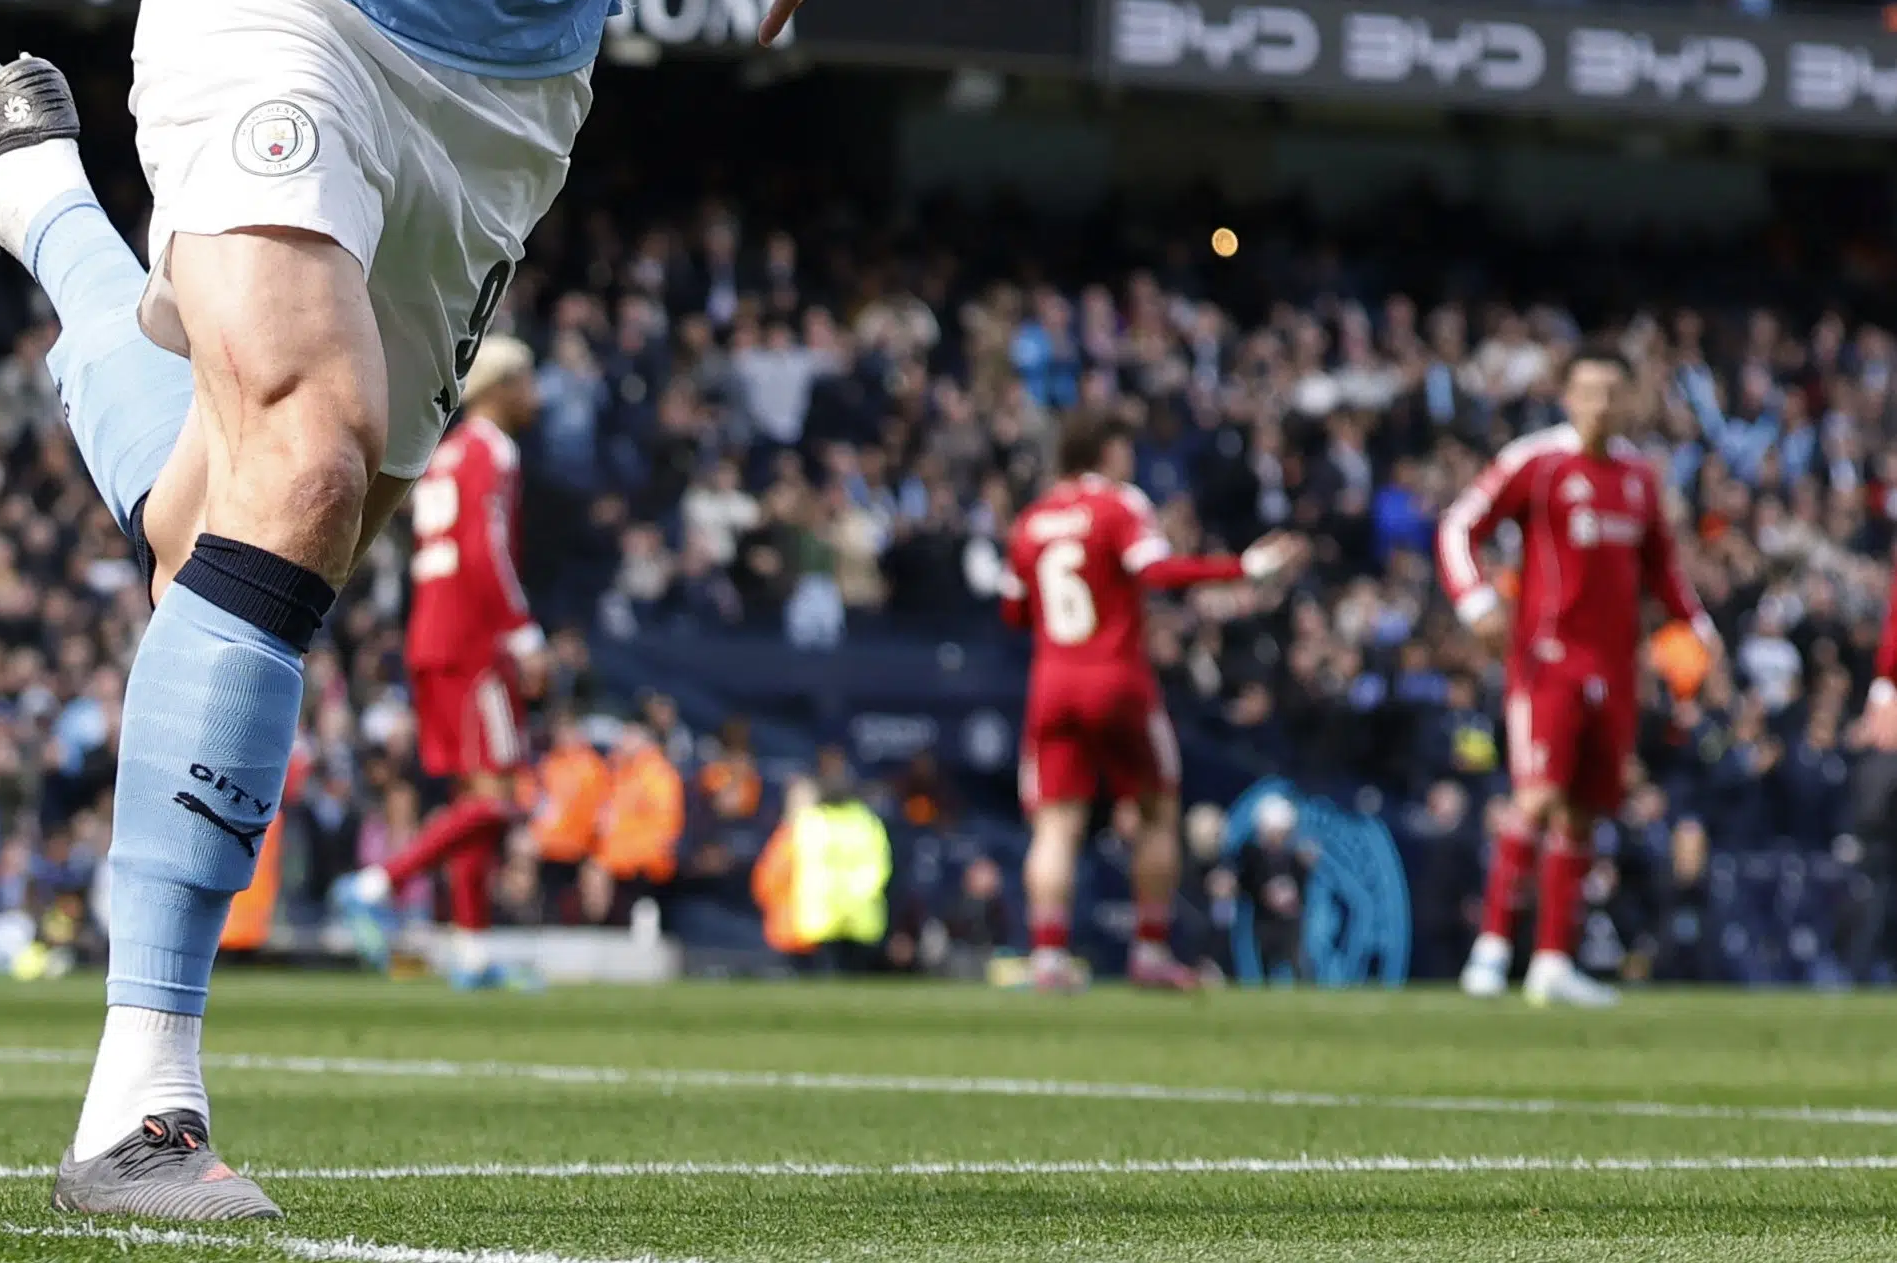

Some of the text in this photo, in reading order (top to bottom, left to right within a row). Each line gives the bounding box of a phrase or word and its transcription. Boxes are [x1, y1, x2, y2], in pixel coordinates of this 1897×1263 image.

[265, 163, 290, 173] CITY
[455, 259, 510, 381] 9
[1036, 540, 1098, 646] 6
[189, 763, 272, 815] CITY
